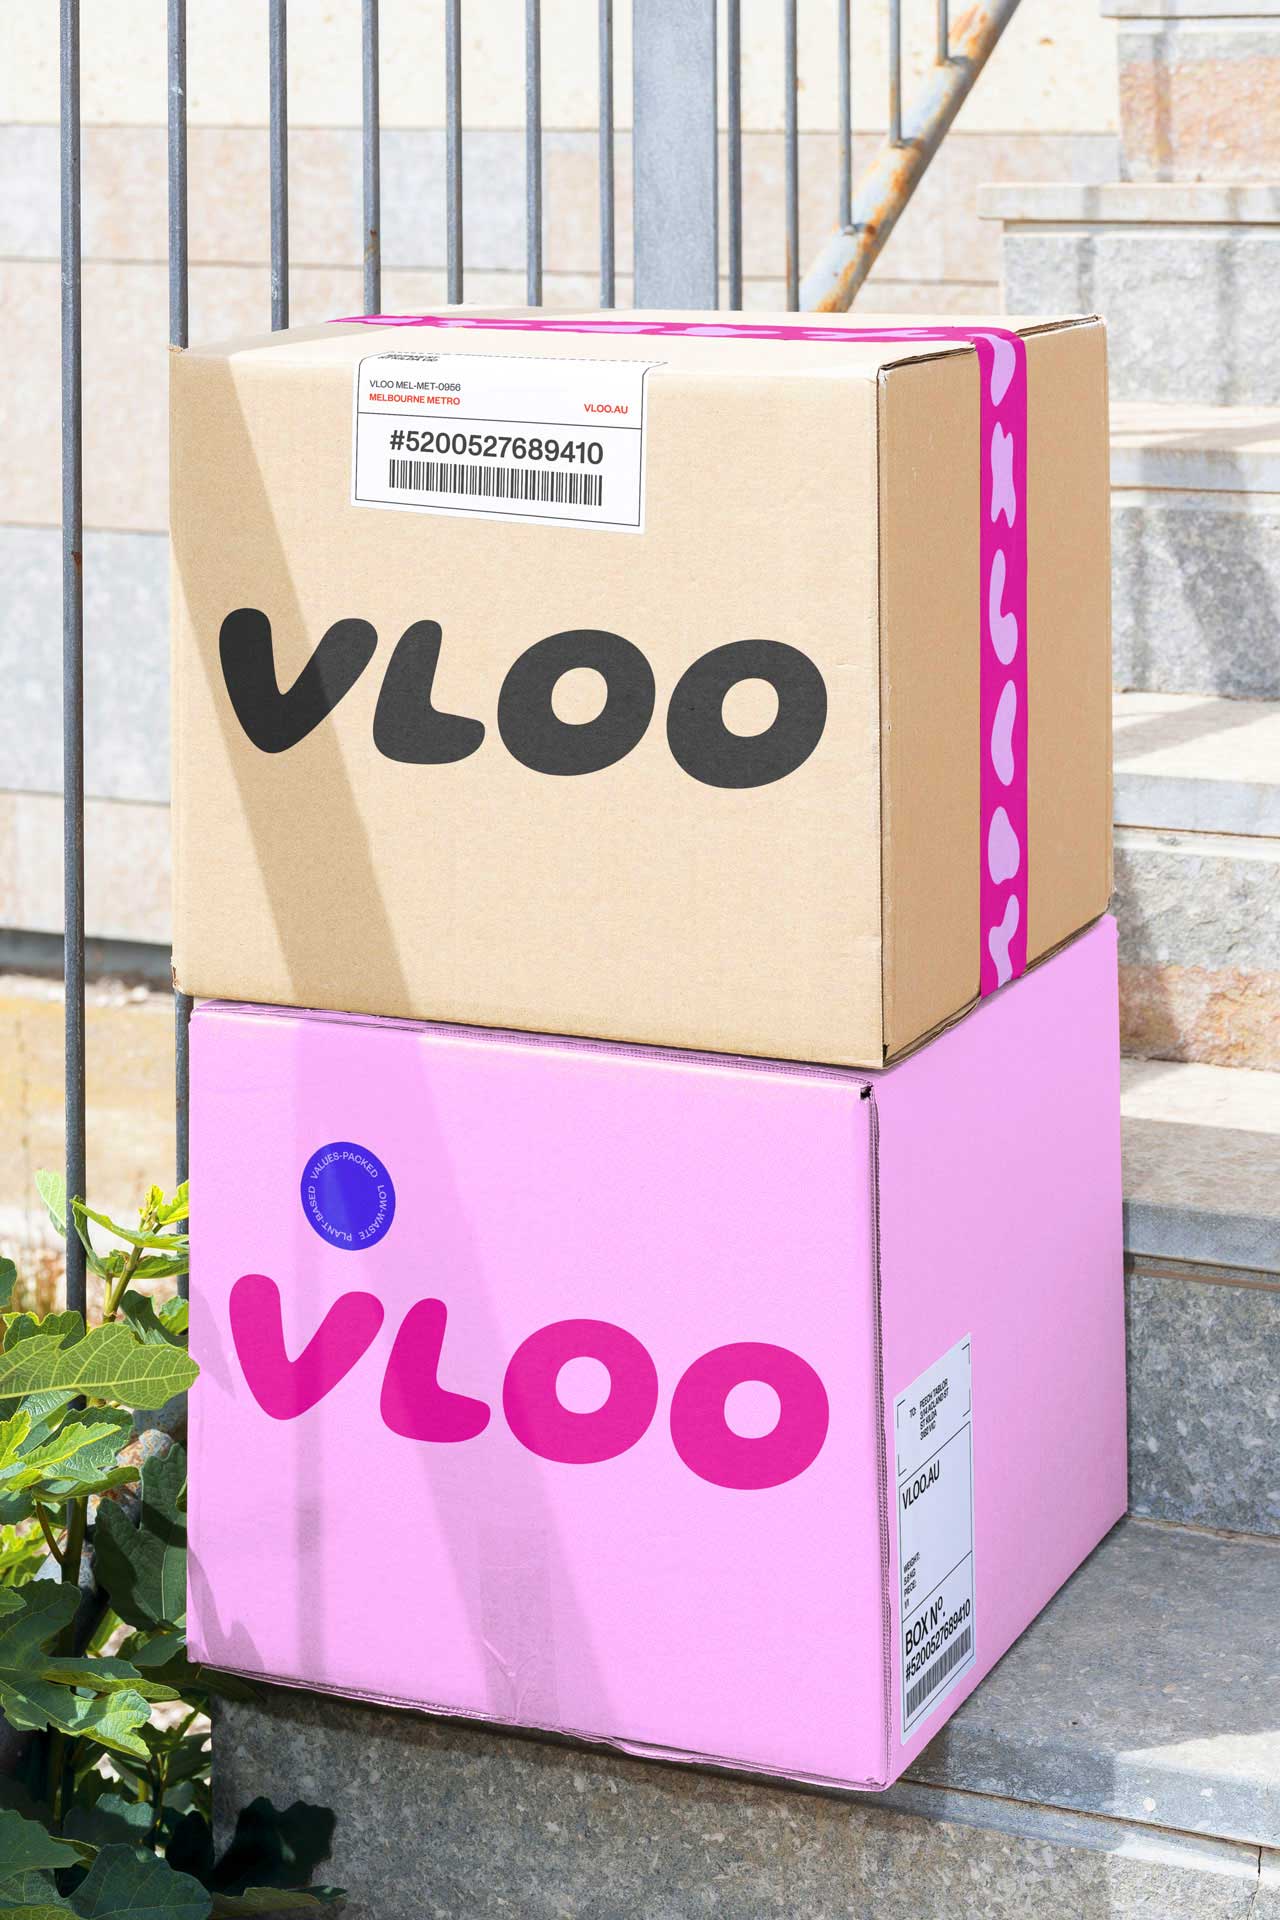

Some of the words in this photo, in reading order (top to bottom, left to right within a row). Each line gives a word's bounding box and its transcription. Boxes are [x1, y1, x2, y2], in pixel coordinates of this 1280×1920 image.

[369, 380, 394, 390] VLOO
[396, 381, 461, 392] MEL-MET-0956
[369, 393, 425, 404] MELBOURNE
[426, 396, 461, 406] METRO
[584, 404, 628, 415] VLOO.AU
[390, 430, 604, 465] #5200527689410
[219, 608, 827, 789] VLOO
[310, 1151, 378, 1180] VALUES-PACKED
[308, 1185, 353, 1242] PLANT-BASED
[358, 1184, 387, 1241] LOW-WASTE
[230, 1274, 830, 1490] VLOO
[919, 1391, 933, 1410] PEECH
[901, 1460, 941, 1510] VLOO.AU
[905, 1610, 929, 1658] BOX
[905, 1598, 971, 1683] #5200527689410
